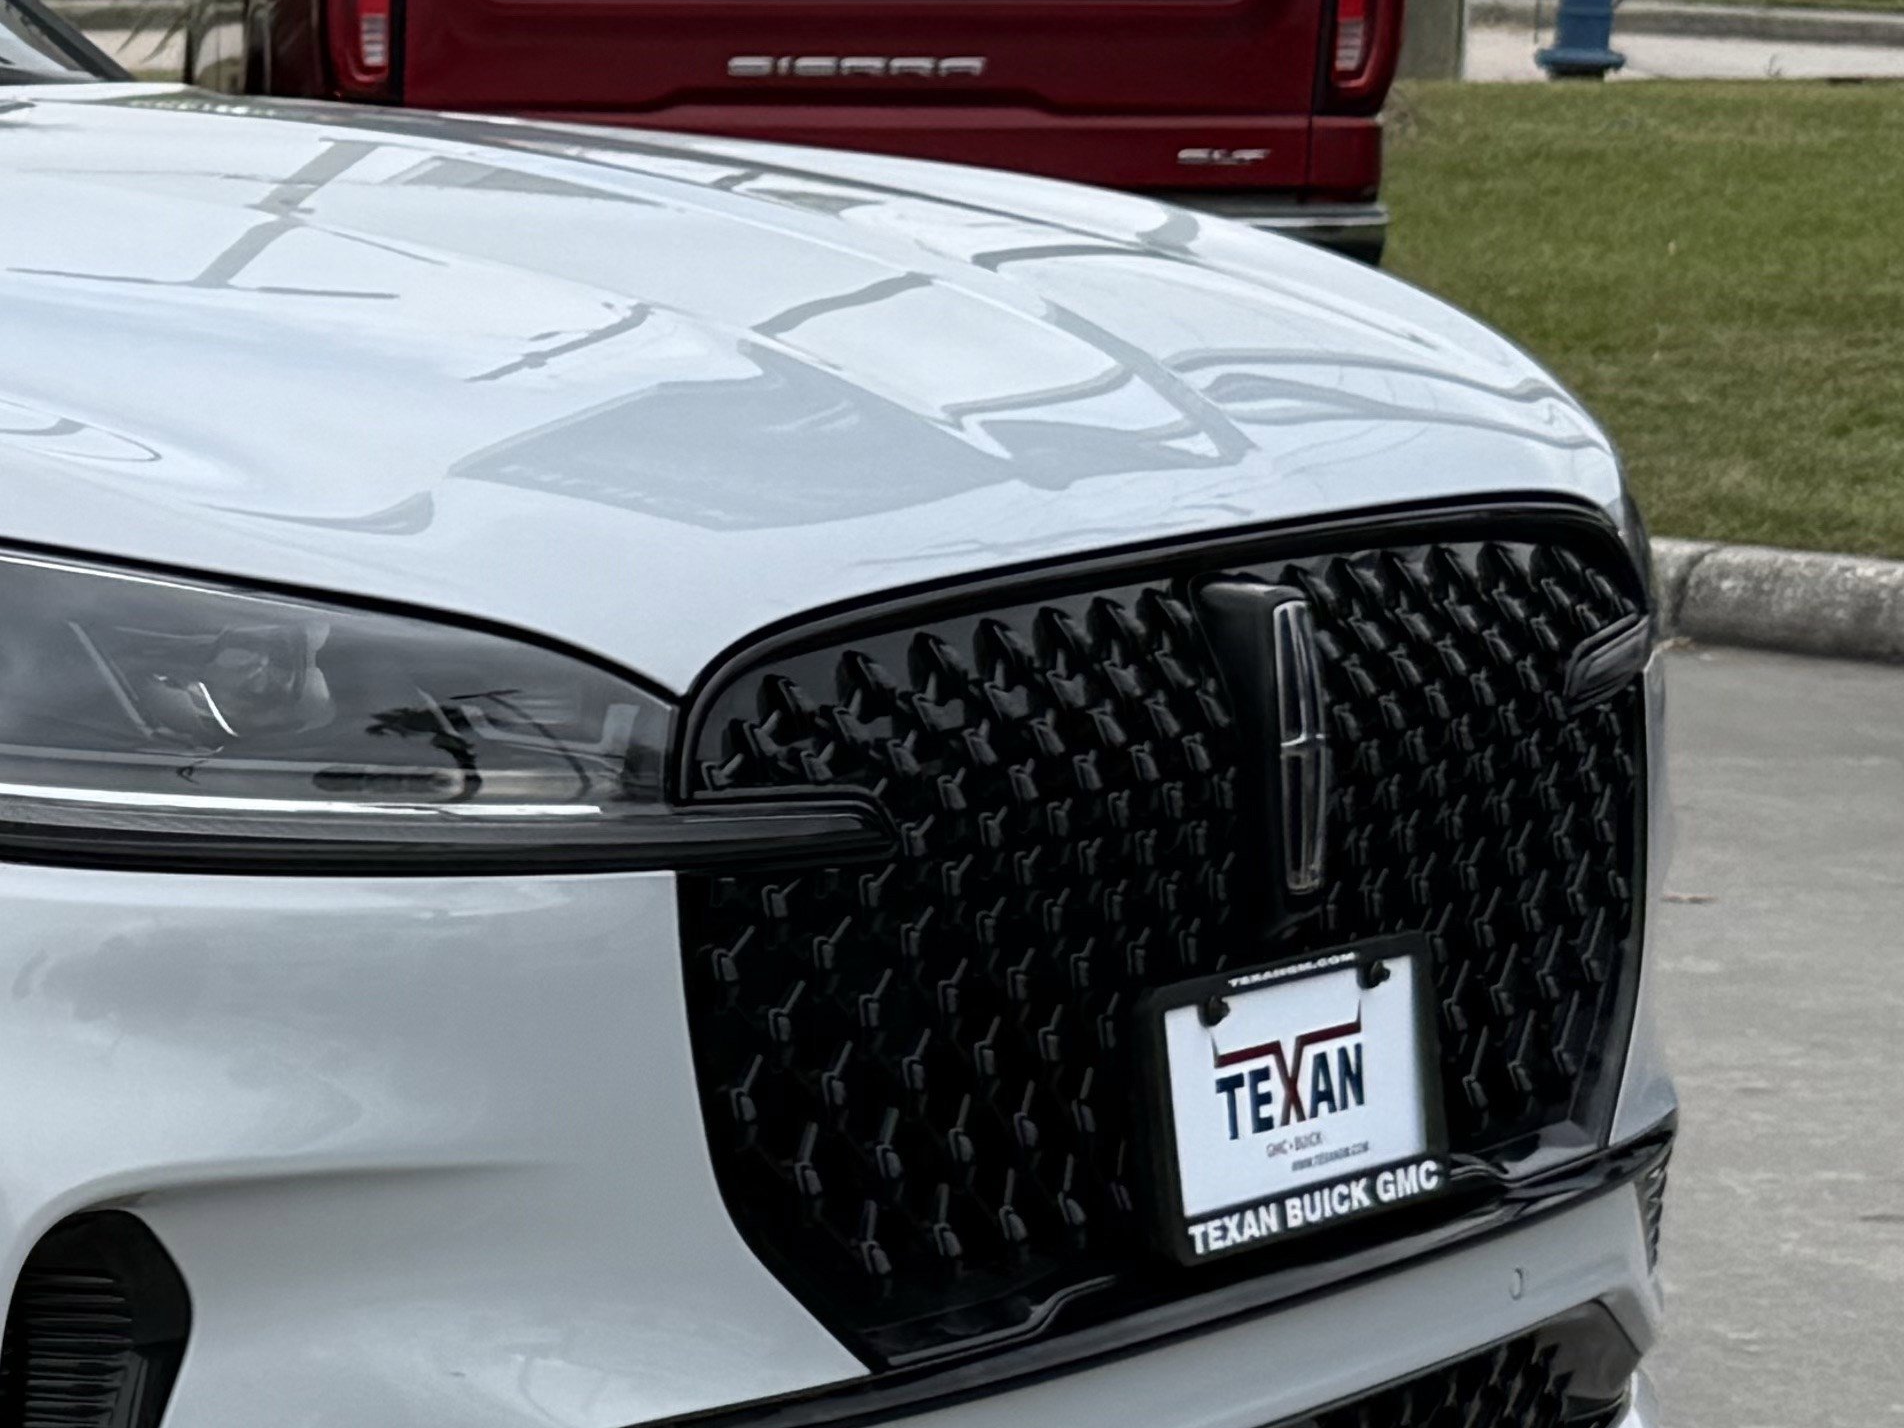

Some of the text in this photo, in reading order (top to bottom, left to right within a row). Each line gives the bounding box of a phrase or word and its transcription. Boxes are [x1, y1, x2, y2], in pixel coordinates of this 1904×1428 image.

[727, 55, 987, 76] SIERRA
[1211, 999, 1366, 1140] TEXAN
[1188, 1160, 1440, 1256] TEXAN BUICK GMC
